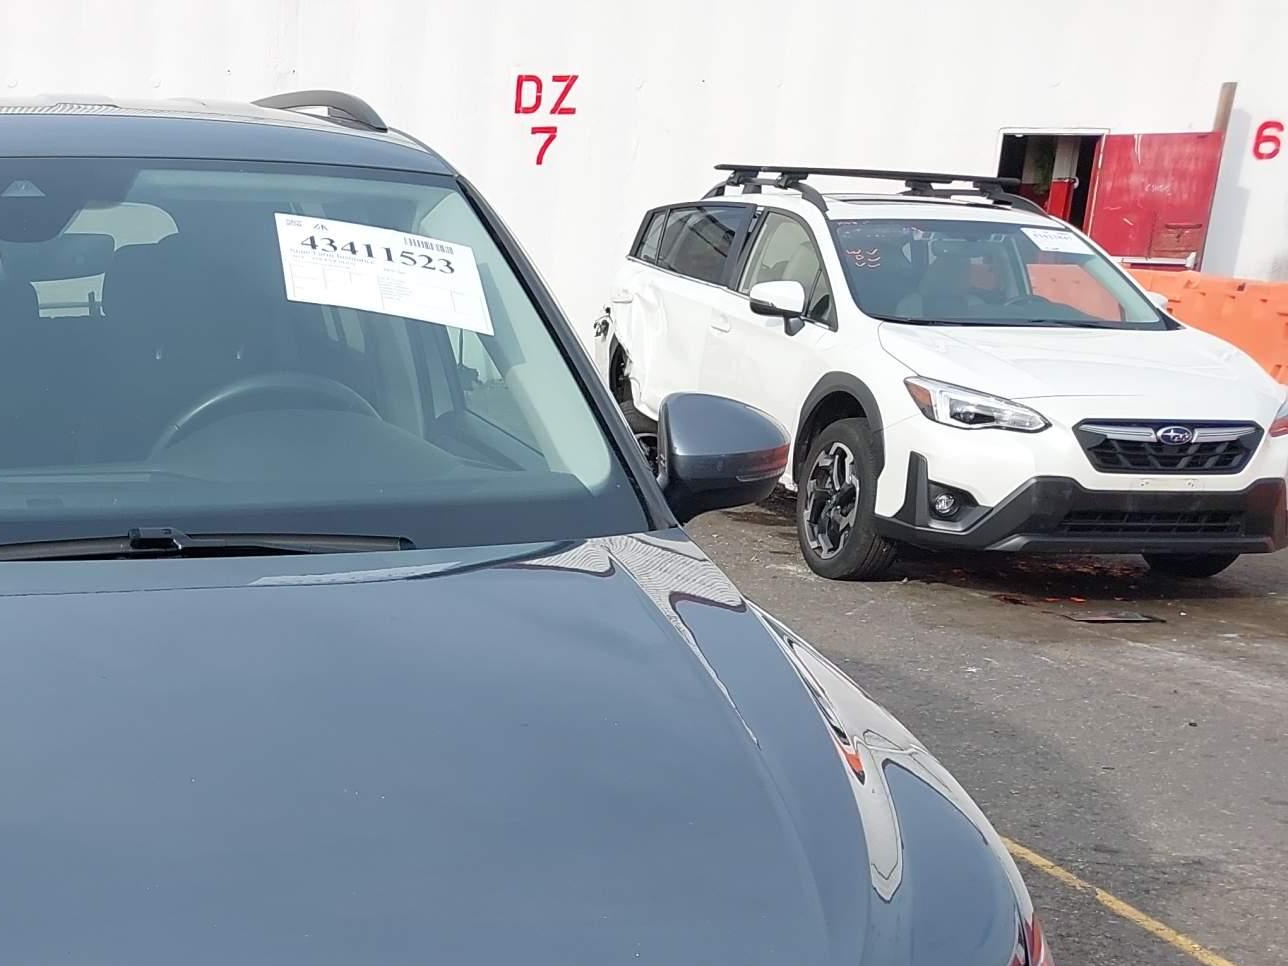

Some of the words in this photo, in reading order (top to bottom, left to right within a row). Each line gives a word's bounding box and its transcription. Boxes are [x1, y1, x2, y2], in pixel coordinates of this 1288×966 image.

[514, 74, 579, 116] DZ
[531, 125, 558, 166] 7
[1252, 120, 1285, 161] 6
[300, 234, 456, 275] 43411523
